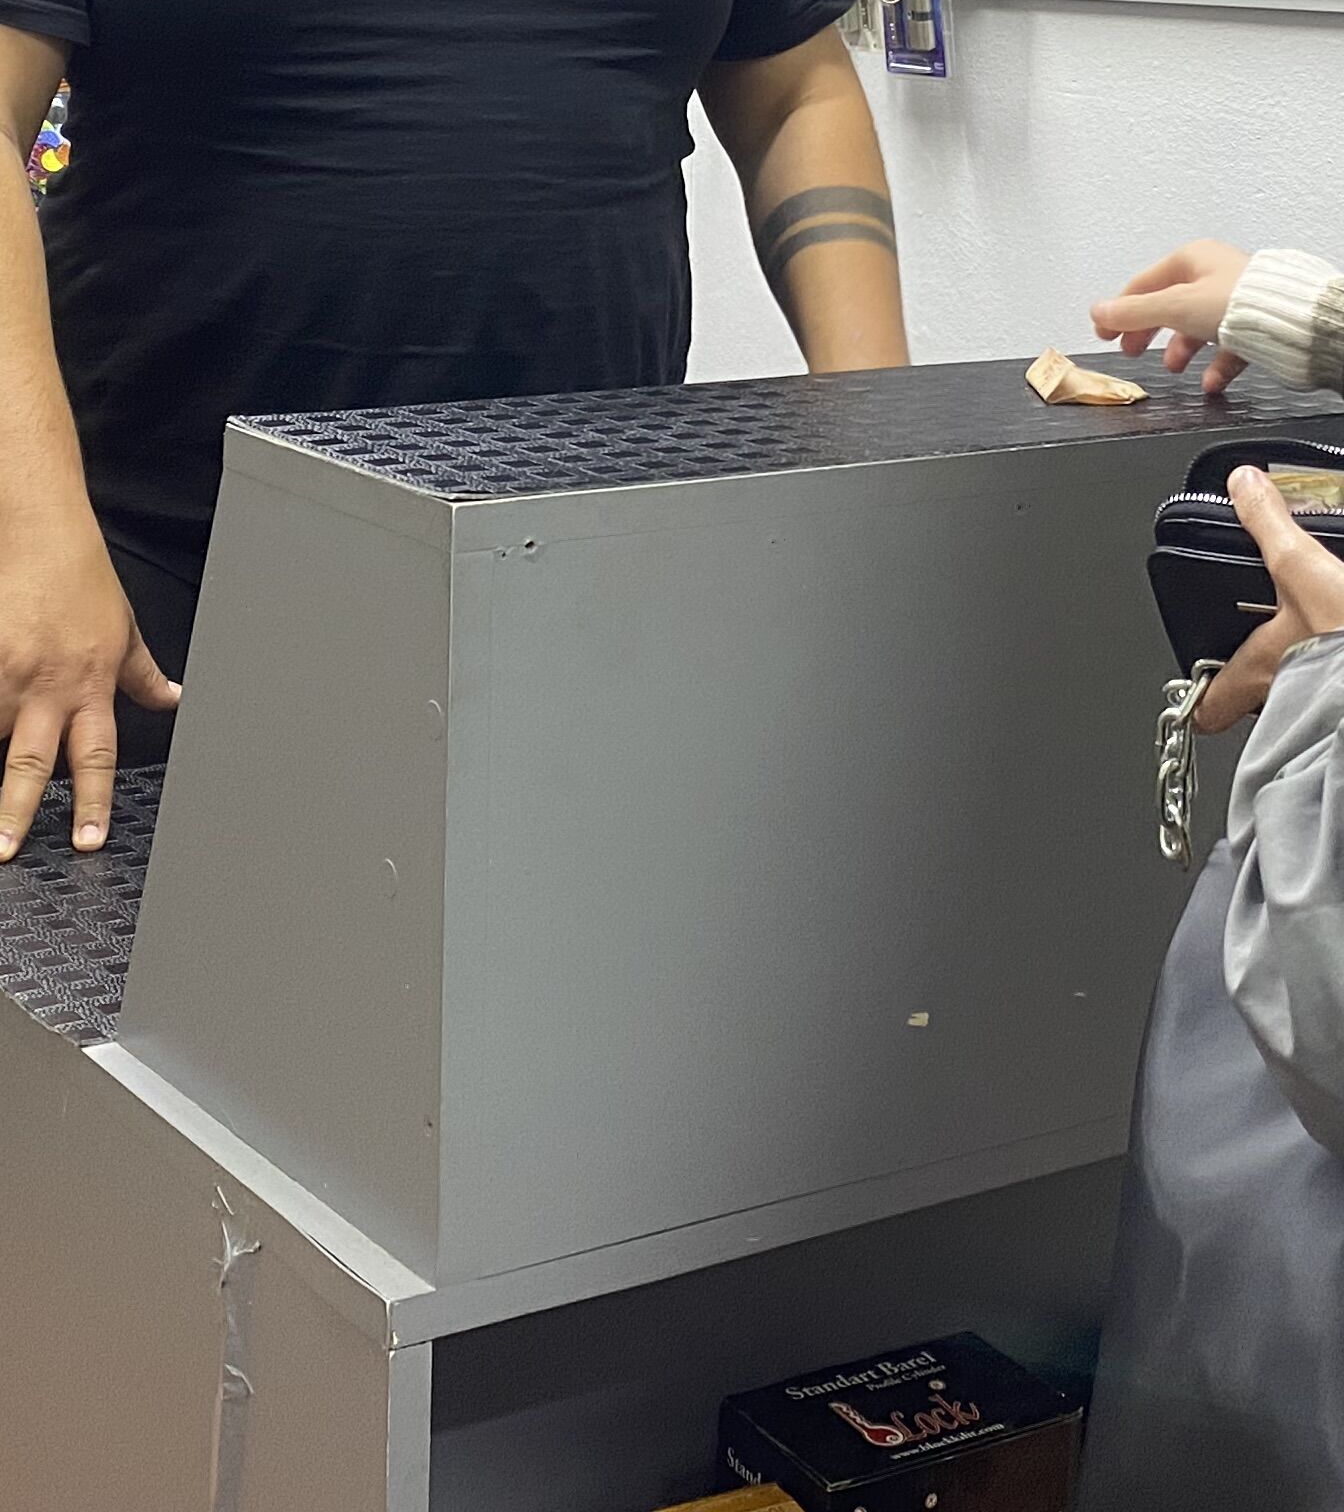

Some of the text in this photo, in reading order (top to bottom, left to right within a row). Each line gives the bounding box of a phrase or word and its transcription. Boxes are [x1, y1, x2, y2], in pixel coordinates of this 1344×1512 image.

[785, 1350, 938, 1401] Standart Barel
[726, 1445, 763, 1485] Stand
